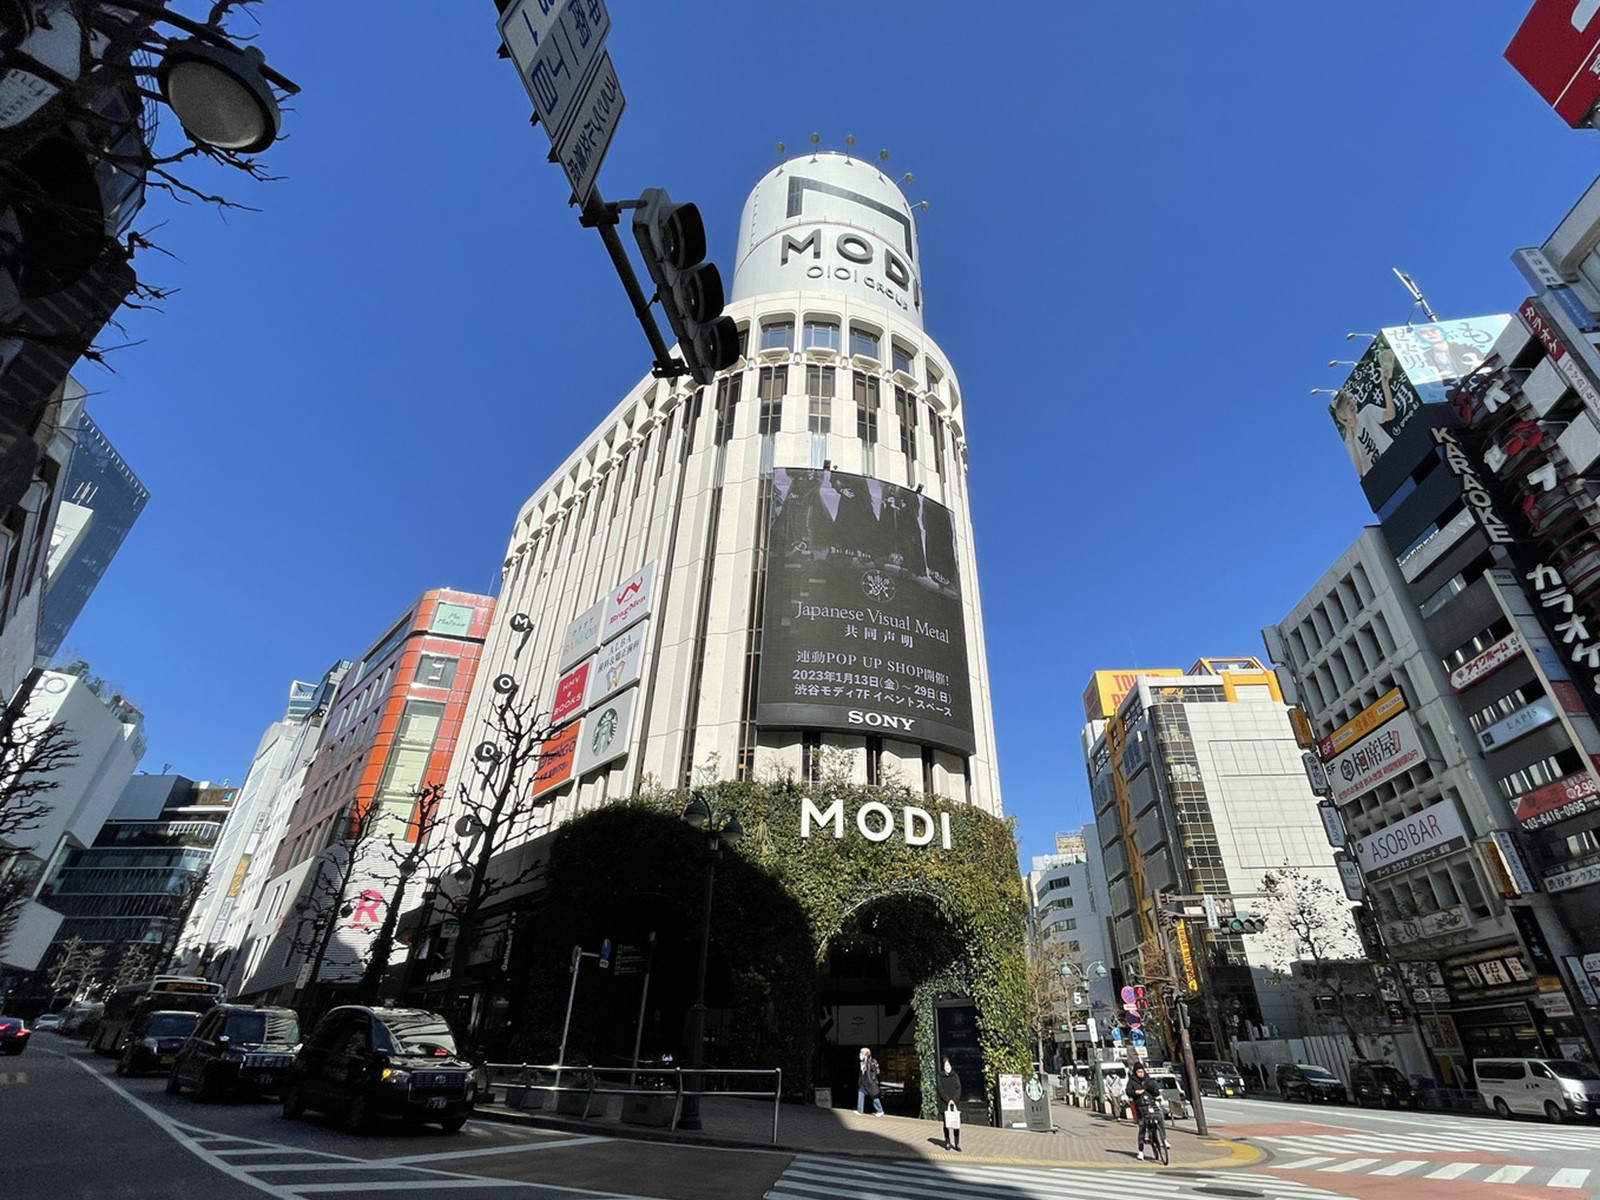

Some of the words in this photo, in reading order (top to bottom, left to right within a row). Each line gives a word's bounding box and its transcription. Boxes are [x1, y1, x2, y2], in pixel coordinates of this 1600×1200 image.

[781, 228, 920, 314] MODI
[1525, 306, 1558, 354] カラオケ
[1431, 427, 1515, 543] KARAOKE
[795, 601, 865, 621] Japanese
[866, 608, 911, 631] Visual
[914, 619, 950, 644] Metal
[862, 656, 882, 669] UP
[562, 674, 582, 692] HMV
[553, 692, 583, 716] BOOKS
[1506, 707, 1538, 730] LAPIS
[848, 710, 916, 732] SONY
[800, 797, 952, 850] MODI
[1527, 801, 1587, 830] 03-6416-0995
[1371, 814, 1443, 862] ASOBIBAR
[353, 889, 383, 923] R
[1073, 991, 1082, 1004] 5
